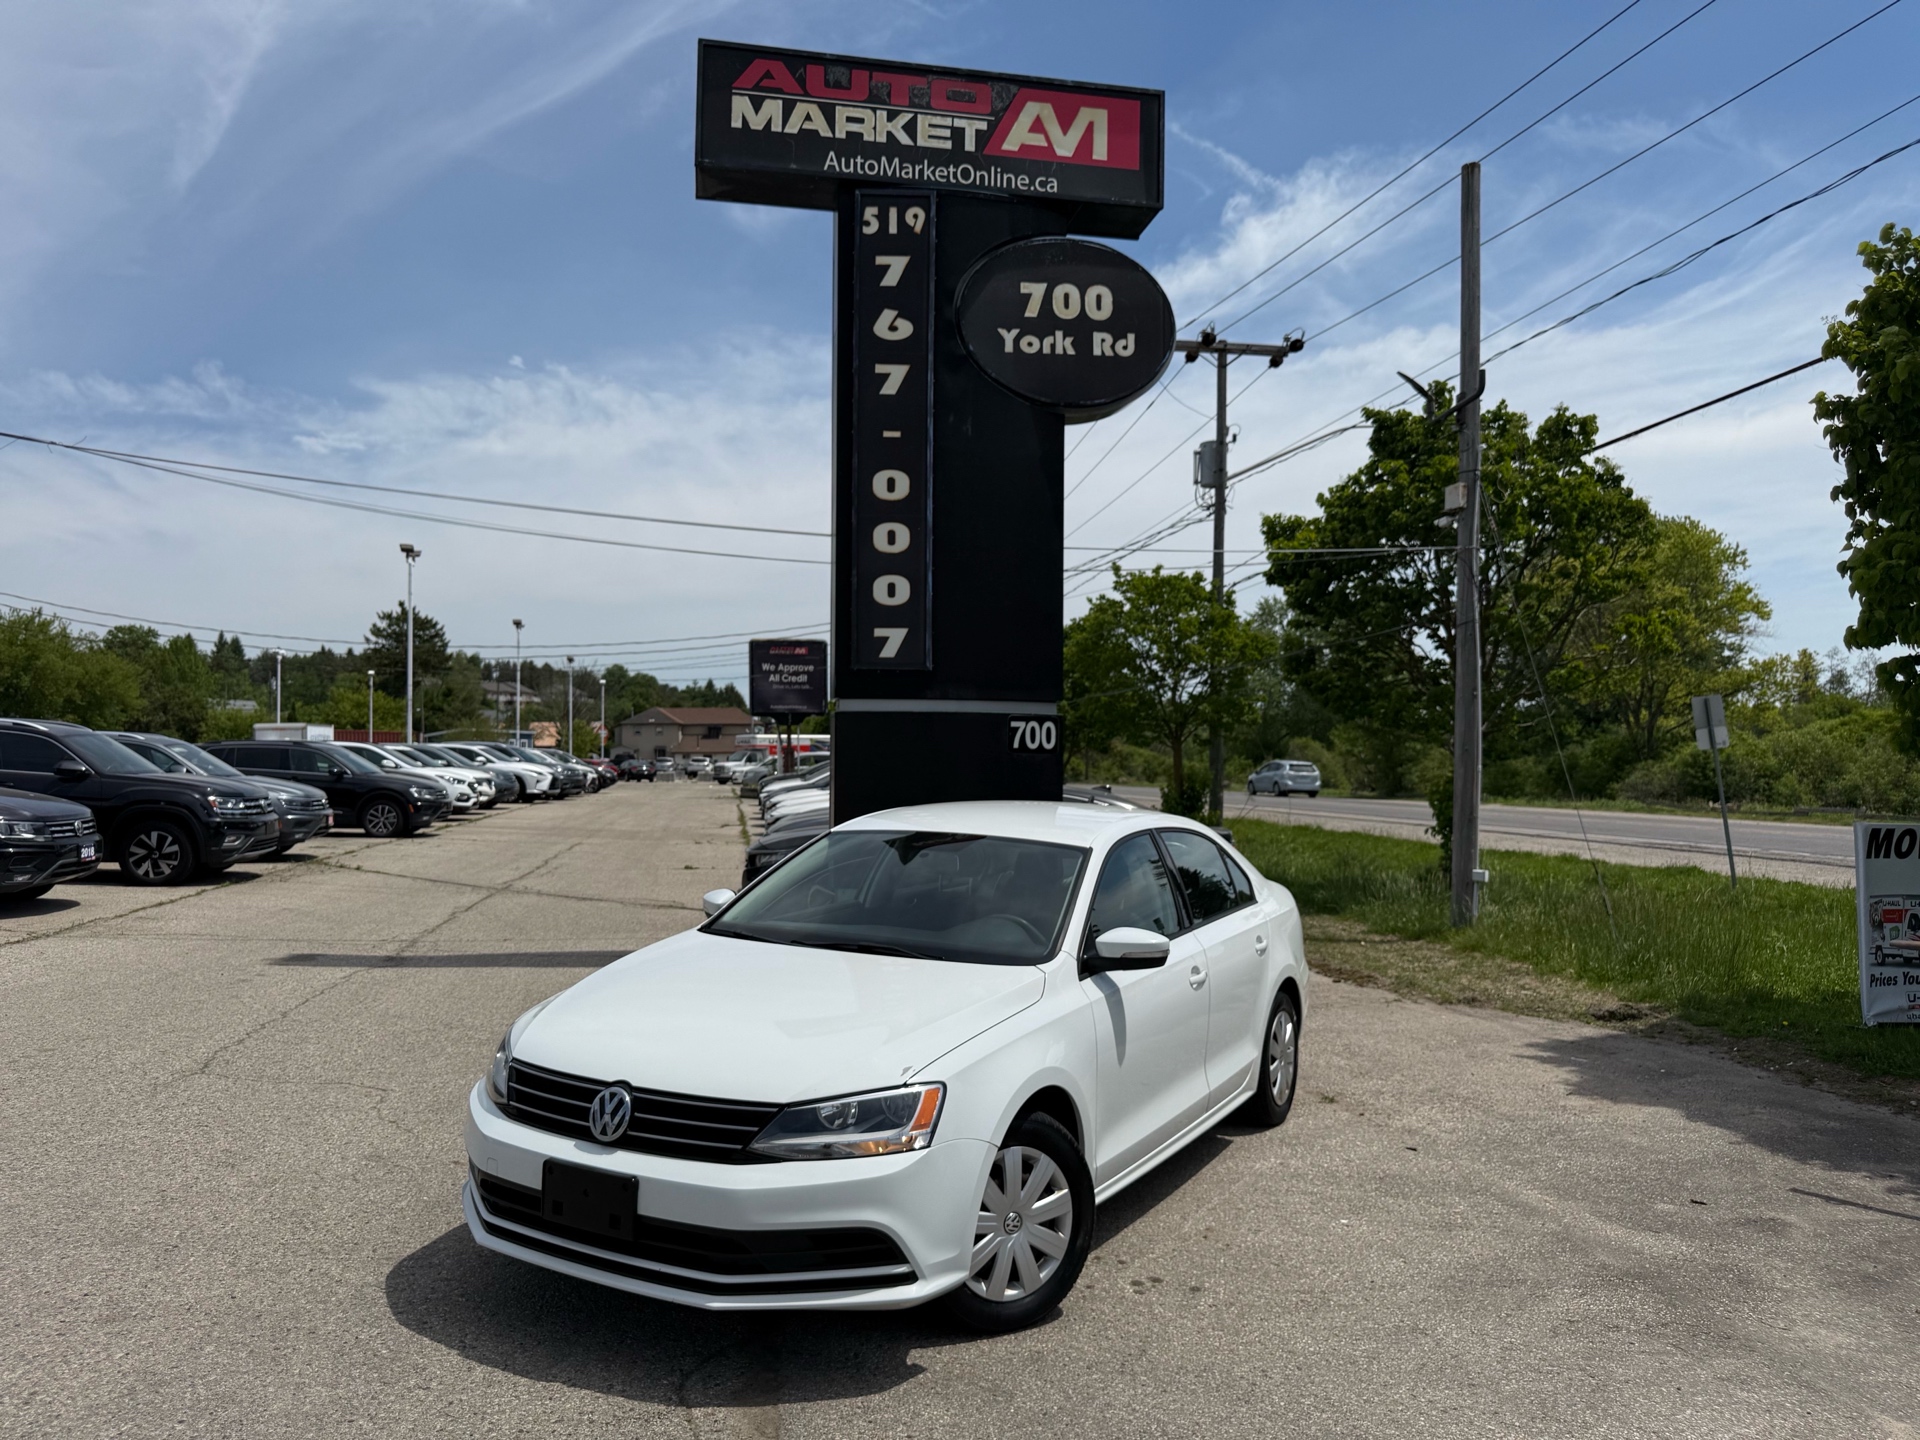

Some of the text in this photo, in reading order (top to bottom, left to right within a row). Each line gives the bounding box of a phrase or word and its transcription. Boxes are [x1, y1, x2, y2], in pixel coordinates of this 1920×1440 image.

[732, 58, 992, 114] AUTO
[731, 95, 988, 152] MARKET
[1001, 101, 1108, 161] AM
[823, 150, 1058, 193] AutoMarketOnline.ca
[862, 206, 926, 235] 519
[1020, 282, 1113, 321] 700
[997, 327, 1135, 357] York Rd
[762, 662, 815, 674] We Approve
[769, 673, 808, 683] All Credit
[1010, 721, 1057, 750] 700
[81, 846, 95, 858] 2018
[1866, 828, 1920, 859] MO
[1870, 972, 1898, 988] Prices
